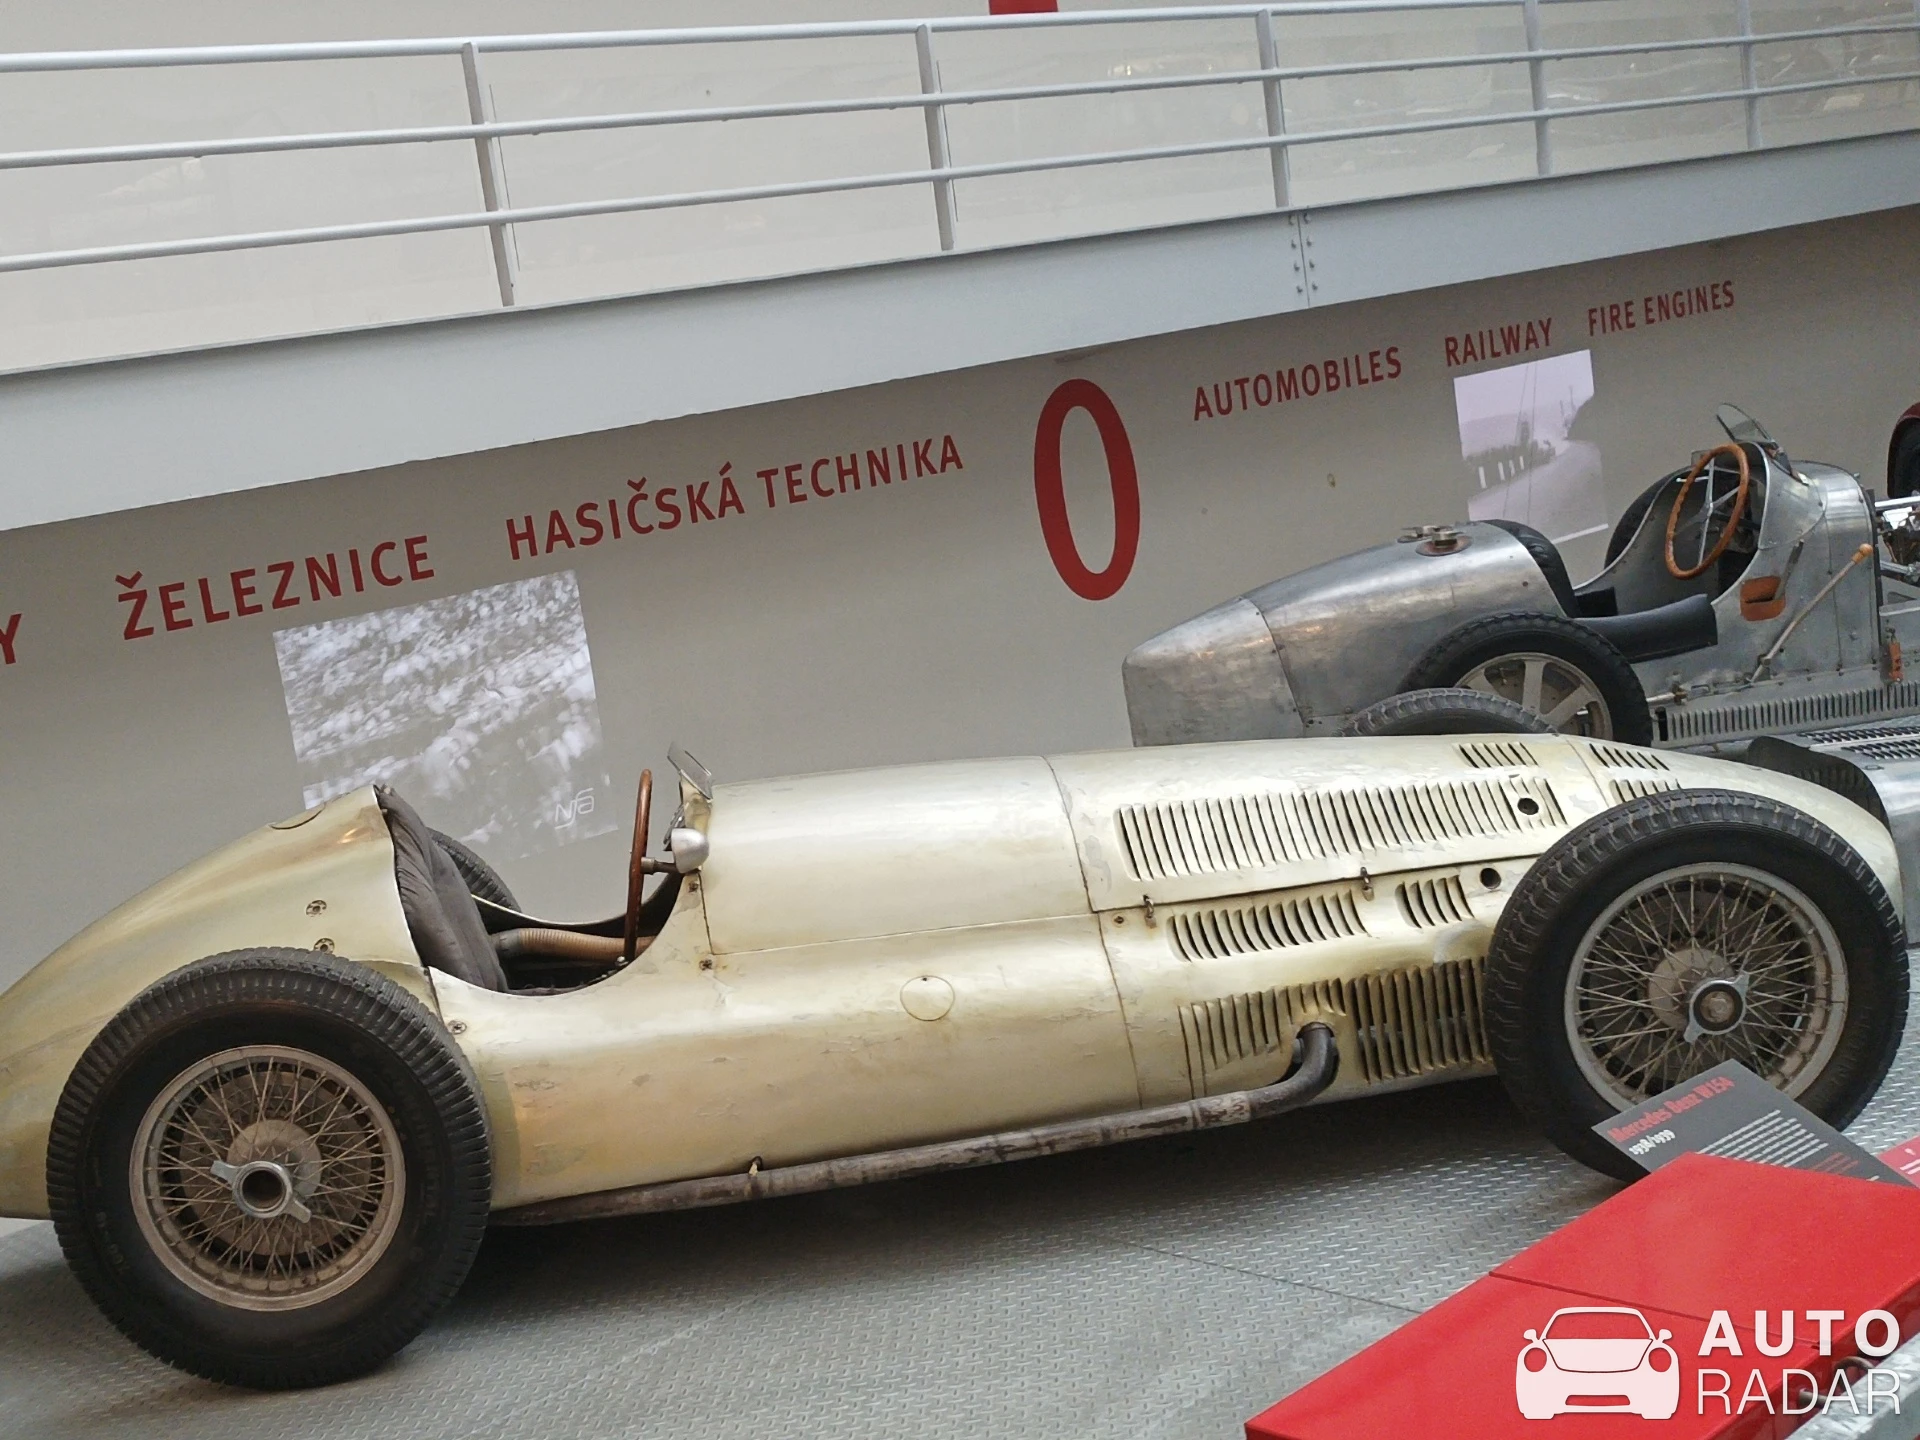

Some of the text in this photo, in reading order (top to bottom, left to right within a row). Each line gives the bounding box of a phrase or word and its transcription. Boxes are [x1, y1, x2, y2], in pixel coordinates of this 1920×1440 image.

[1587, 279, 1736, 337] FIRE ENGINES
[1444, 317, 1553, 368] RAILWAY
[1192, 346, 1402, 422] AUTOMOBILES
[506, 434, 964, 561] HASIČSKÁ TECHNIKA
[115, 534, 435, 641] ŽELEZNICE
[1607, 1109, 1672, 1142] Mercedes
